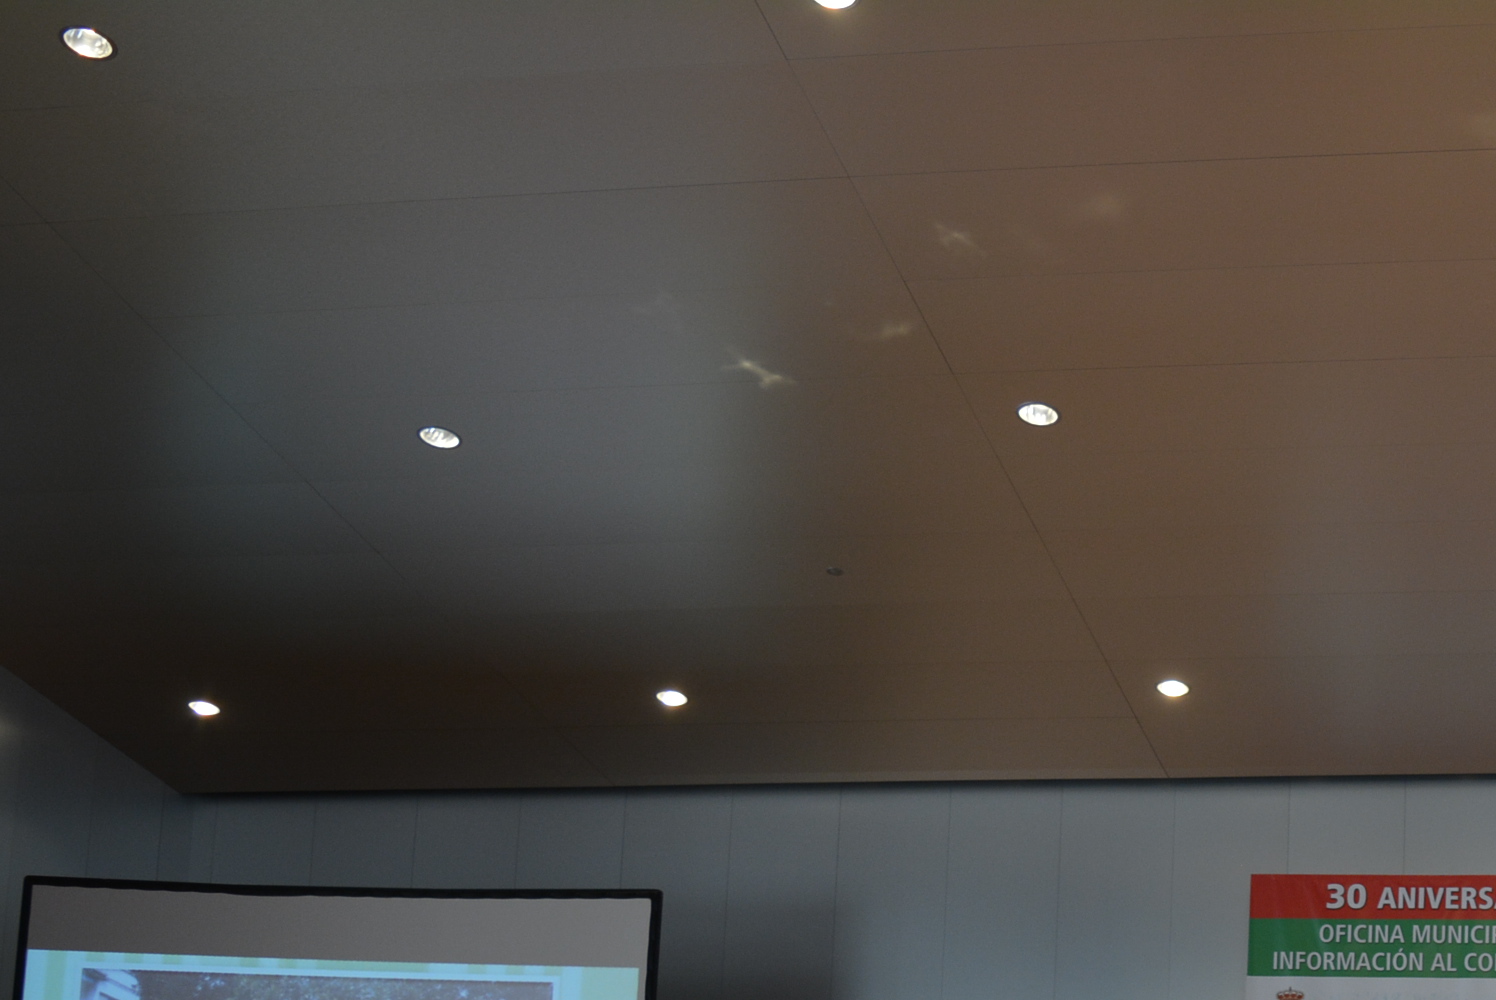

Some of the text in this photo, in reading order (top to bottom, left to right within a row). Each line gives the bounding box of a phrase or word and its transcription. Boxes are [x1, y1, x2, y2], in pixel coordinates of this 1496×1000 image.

[1326, 884, 1367, 909] 30
[1319, 924, 1405, 943] OFICINA
[1272, 948, 1423, 971] INFORMACIÓN
[1431, 952, 1457, 971] AL
